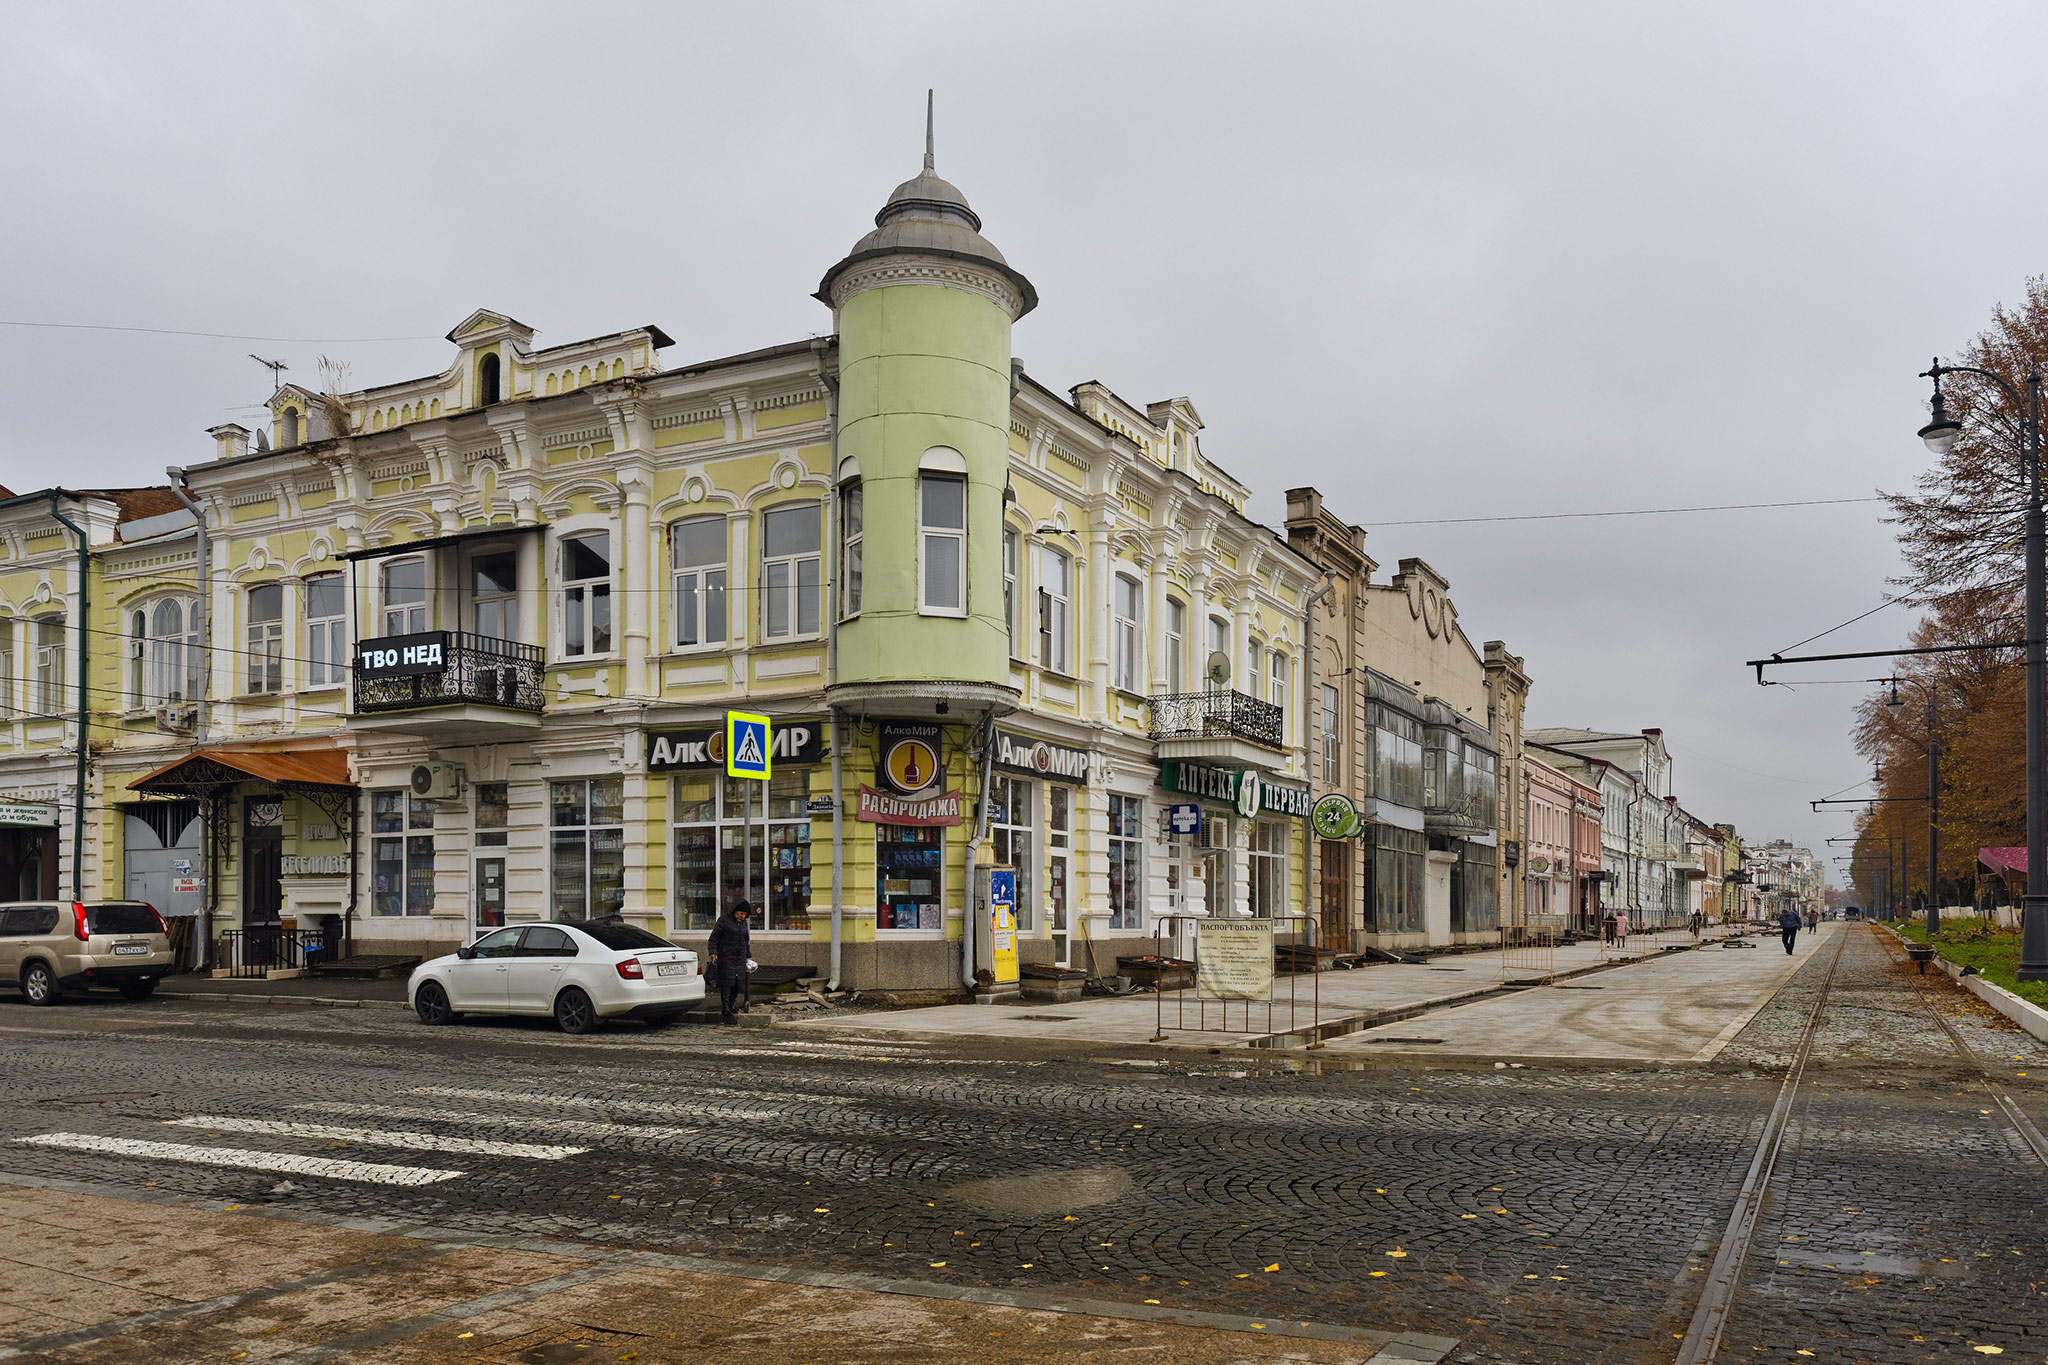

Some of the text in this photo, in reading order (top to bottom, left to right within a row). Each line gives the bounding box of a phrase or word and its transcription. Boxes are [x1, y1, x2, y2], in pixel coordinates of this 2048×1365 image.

[361, 643, 442, 670] ТВО НЕД
[884, 725, 938, 737] АлкоМИР
[1177, 762, 1235, 801] АПТЕКА
[1265, 785, 1309, 817] ПЕРВАЯ
[861, 793, 959, 820] РАСПРОДАЖА
[1321, 799, 1349, 813] ПЕРВАЯ
[1327, 811, 1340, 821] 24
[16, 814, 39, 822] обувь
[1317, 811, 1337, 834] АПТЕКА
[281, 855, 347, 875] ВЕСЕЛИДЗЕ
